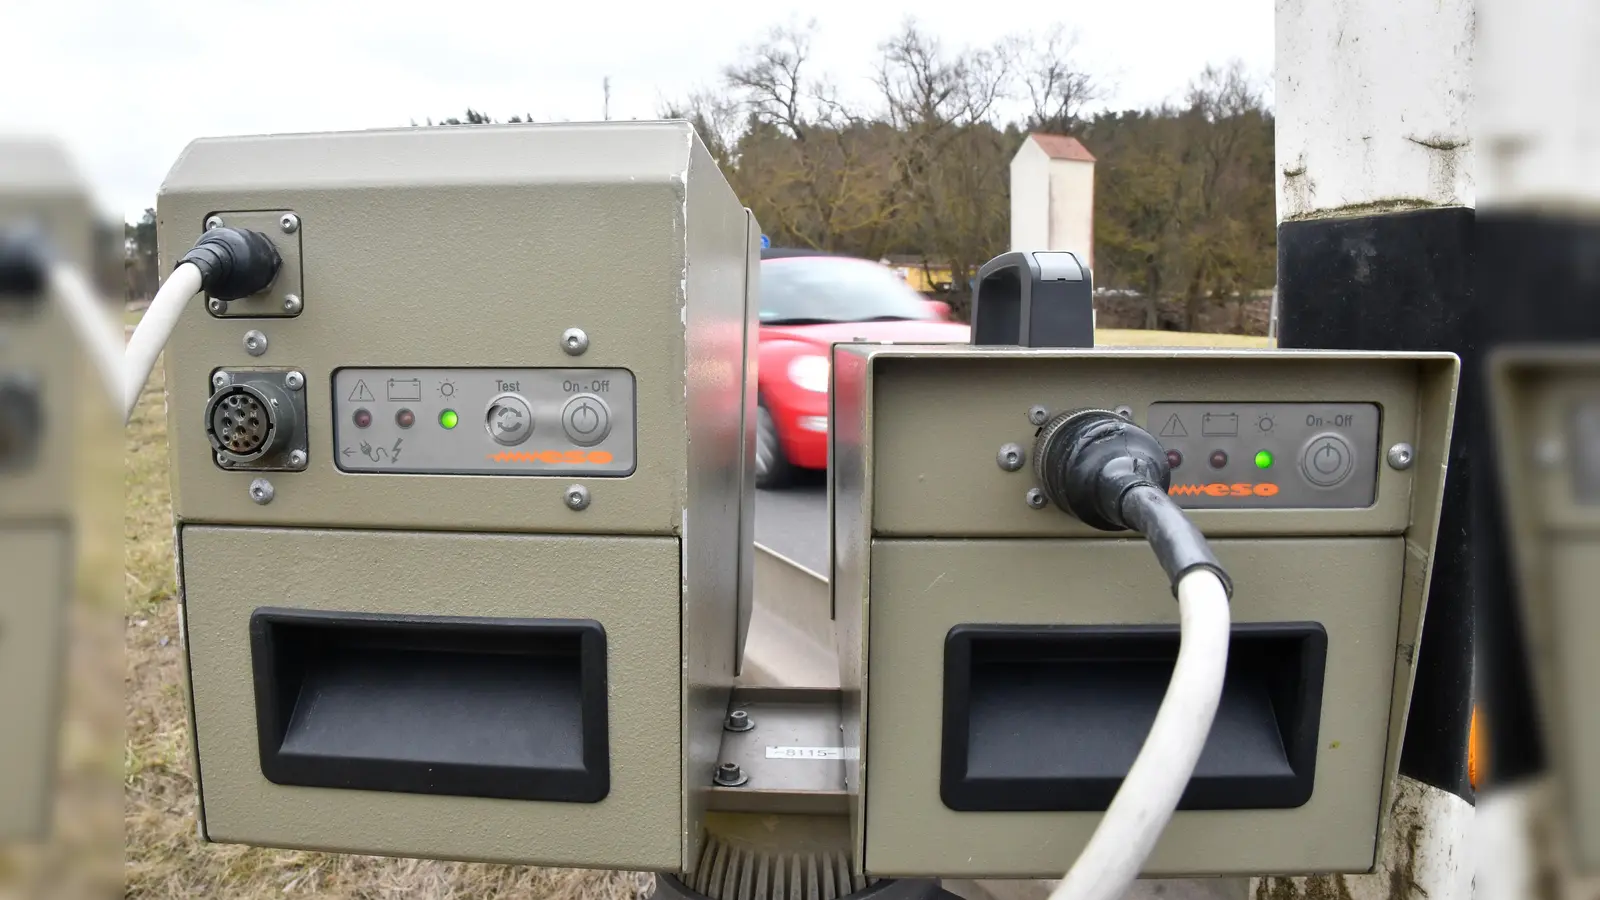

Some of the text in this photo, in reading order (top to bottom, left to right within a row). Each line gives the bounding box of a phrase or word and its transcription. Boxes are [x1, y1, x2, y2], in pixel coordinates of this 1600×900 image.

[496, 380, 520, 392] Test
[562, 380, 579, 392] On
[591, 380, 610, 392] Off
[1306, 414, 1323, 427] On
[1335, 414, 1353, 427] Off
[1206, 483, 1279, 496] eso
